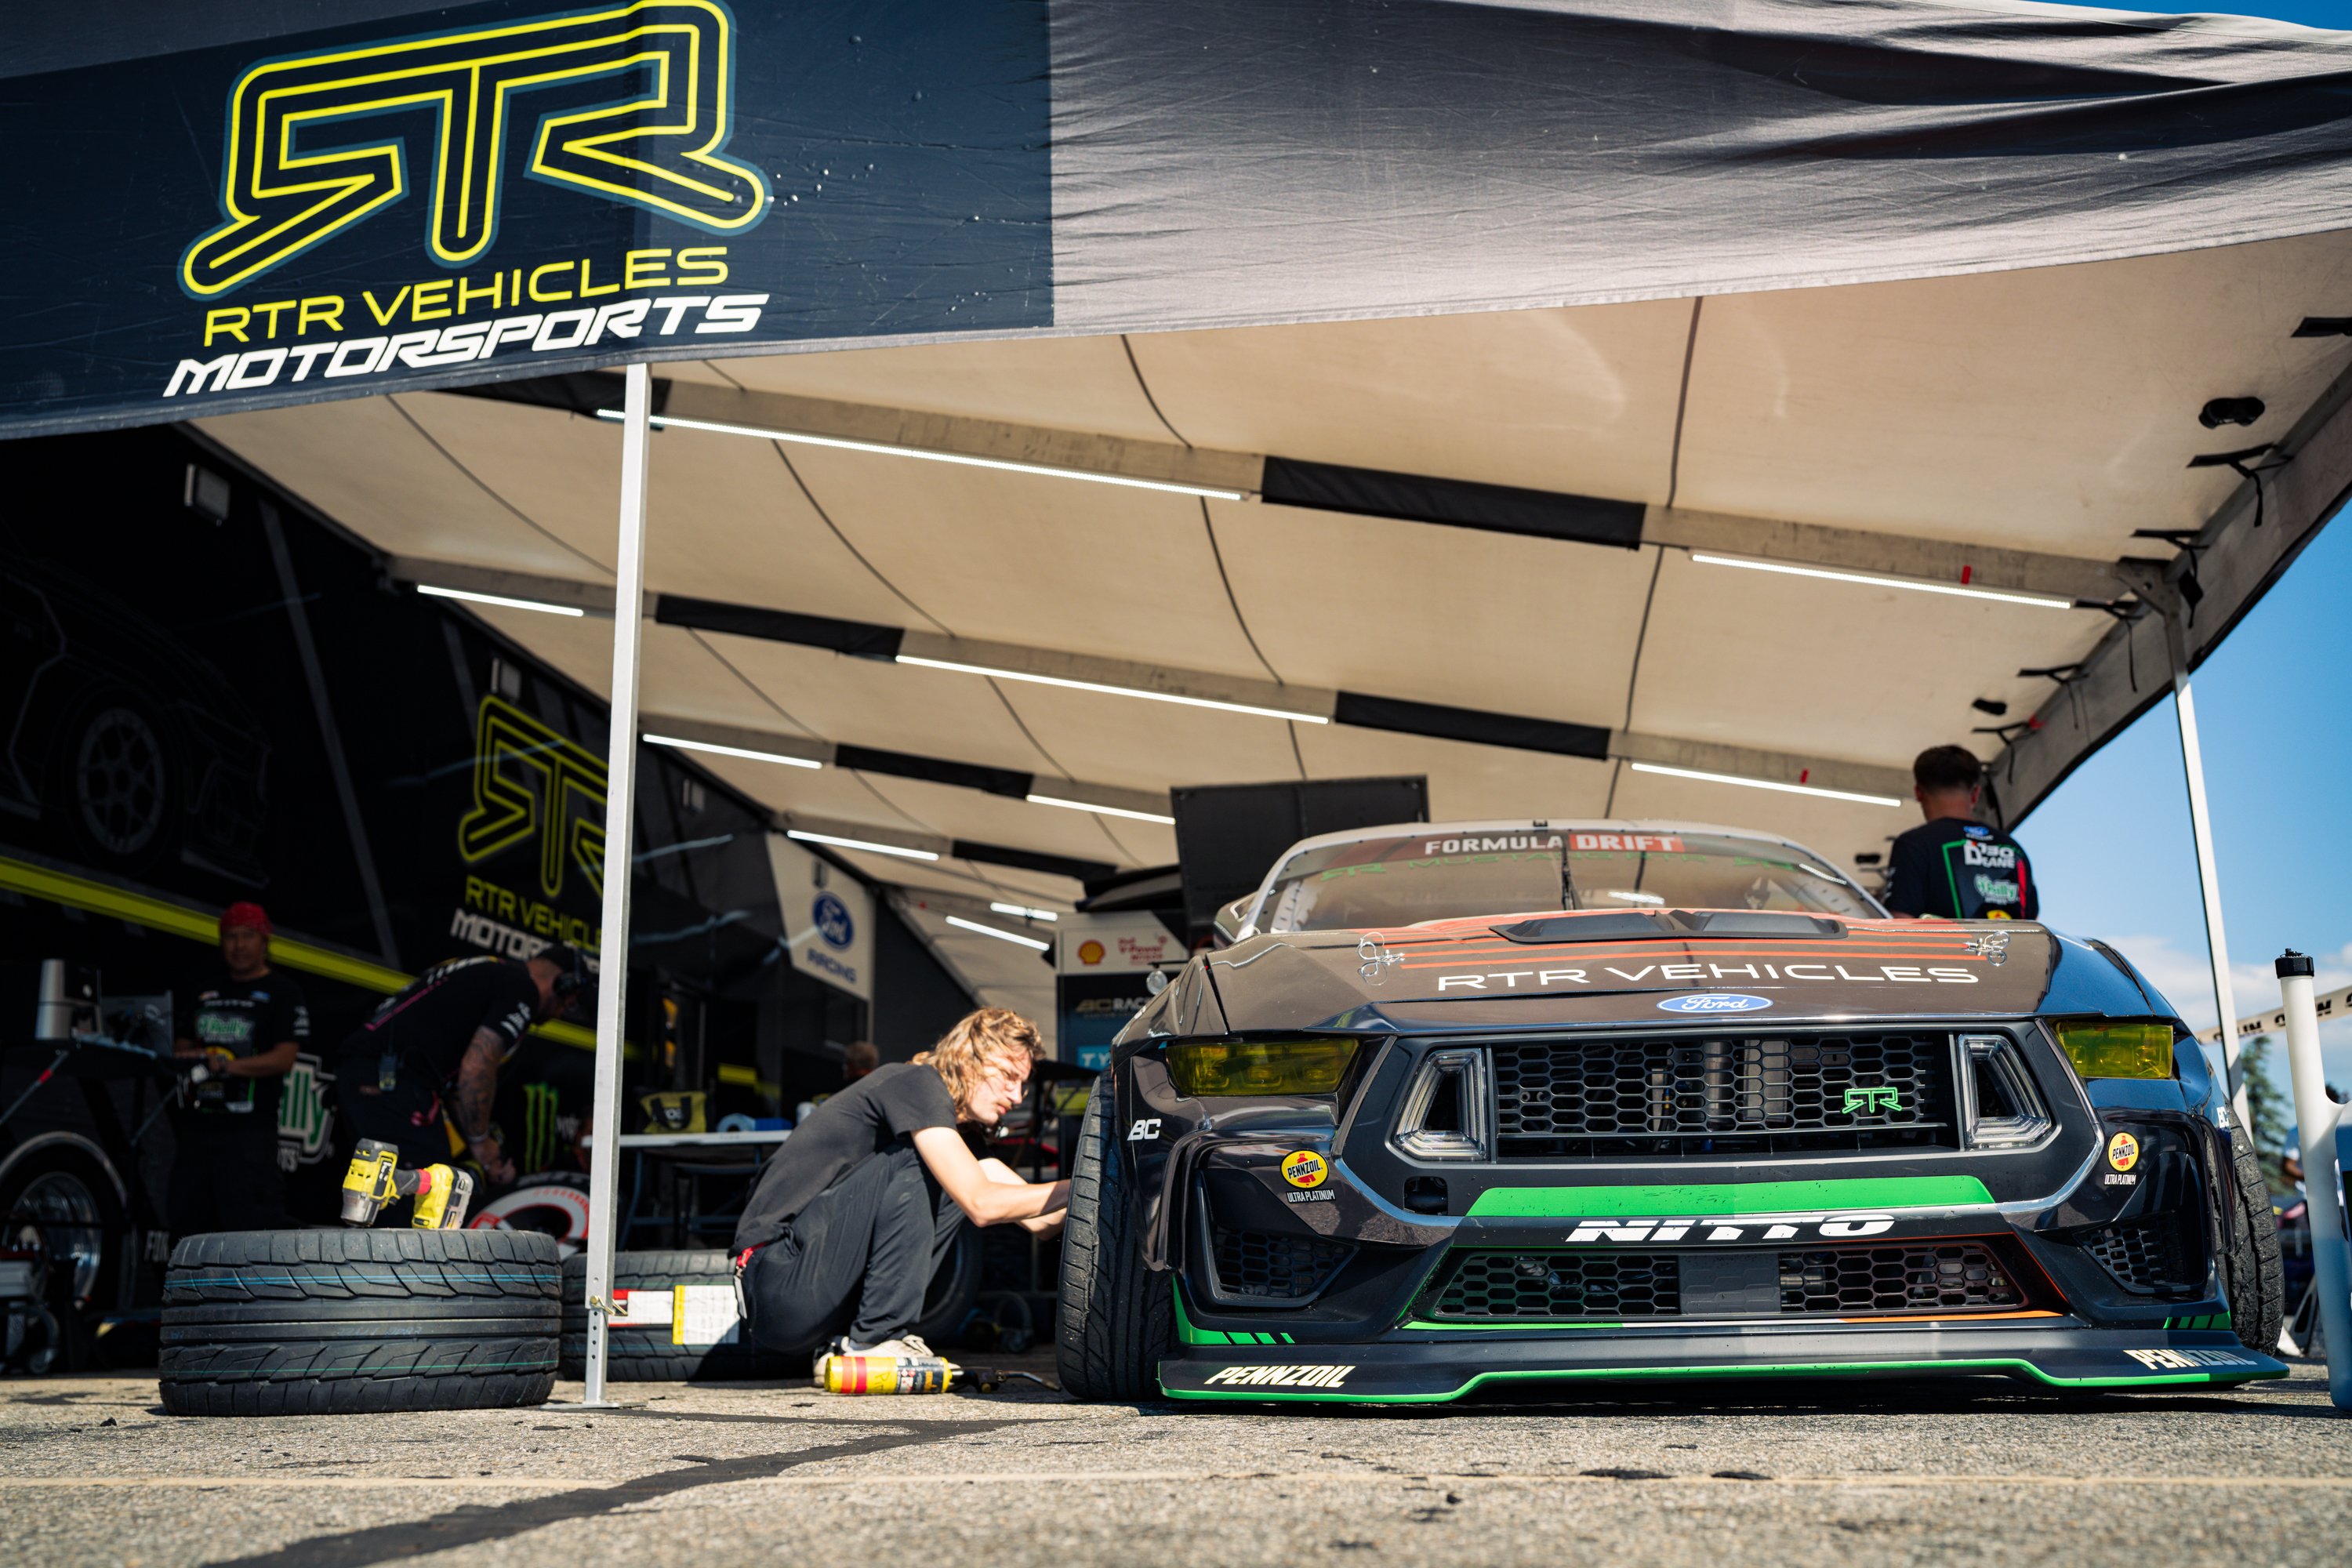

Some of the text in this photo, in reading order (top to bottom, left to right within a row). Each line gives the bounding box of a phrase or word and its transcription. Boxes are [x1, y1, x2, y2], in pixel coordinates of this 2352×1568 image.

[204, 246, 728, 347] RTR VEHICLES
[162, 293, 770, 397] MOTORSPORTS
[1425, 834, 1676, 855] FORMULA DRIFT
[464, 874, 517, 923] RTR
[1438, 964, 1980, 991] RTR VEHICLES
[2216, 1106, 2230, 1127] BC
[1127, 1118, 1161, 1142] BC
[2112, 1143, 2135, 1160] PENNZOIL
[1287, 1159, 1322, 1179] PENNZOIL
[2104, 1174, 2136, 1185] ULTRA PLATINUM
[1287, 1189, 1335, 1203] ULTRA PLATINUM
[1565, 1214, 1895, 1242] NITTO
[2122, 1349, 2259, 1370] PENNZOIL
[1204, 1365, 1356, 1388] PENNZOIL
